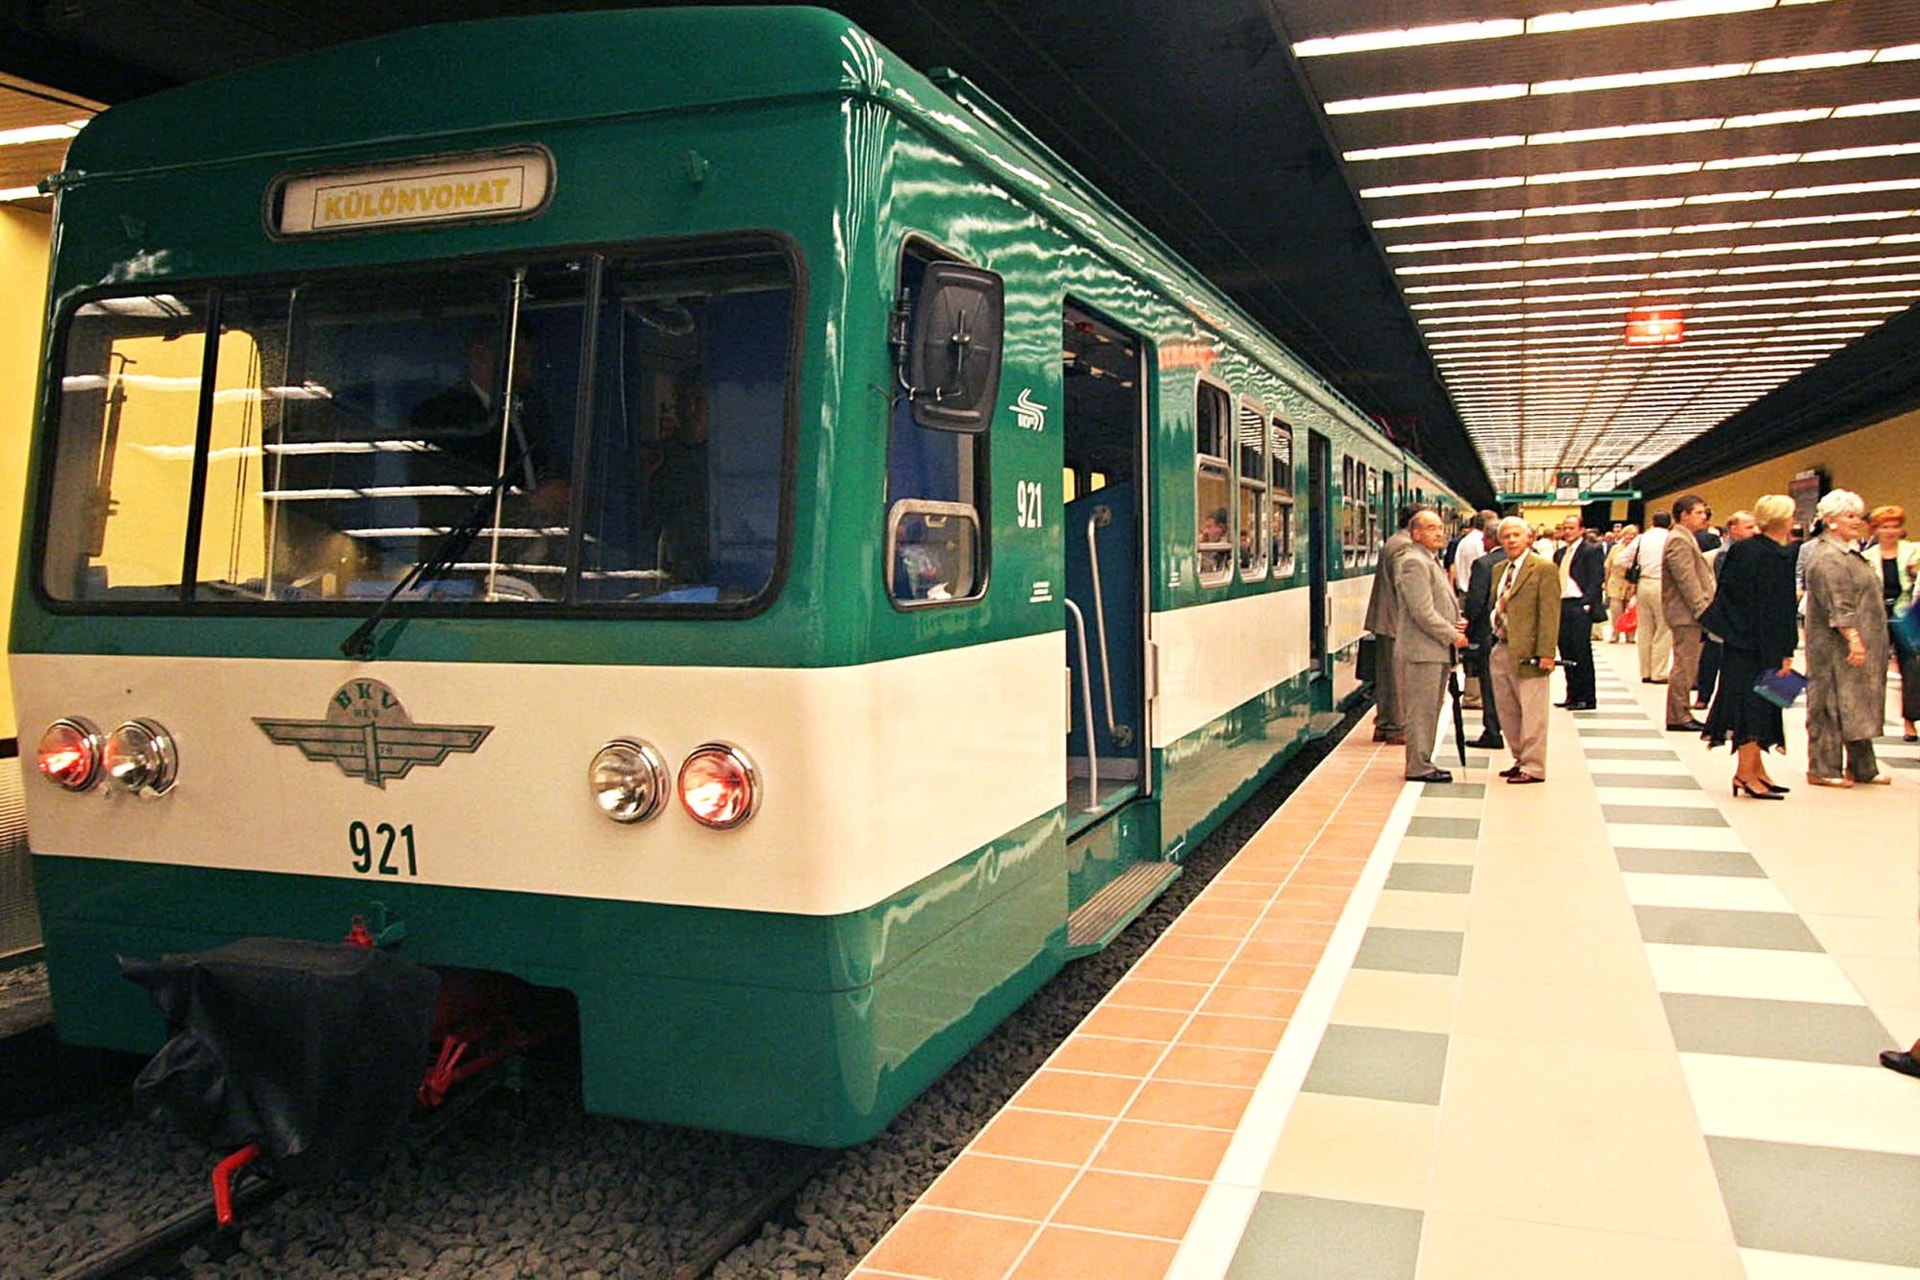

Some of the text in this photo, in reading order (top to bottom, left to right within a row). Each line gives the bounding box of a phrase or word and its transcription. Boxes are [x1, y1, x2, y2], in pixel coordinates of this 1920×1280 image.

[324, 178, 511, 220] KÜLÖNVONAT
[1017, 480, 1043, 528] 921
[334, 682, 399, 710] BKV
[349, 820, 418, 877] 921
